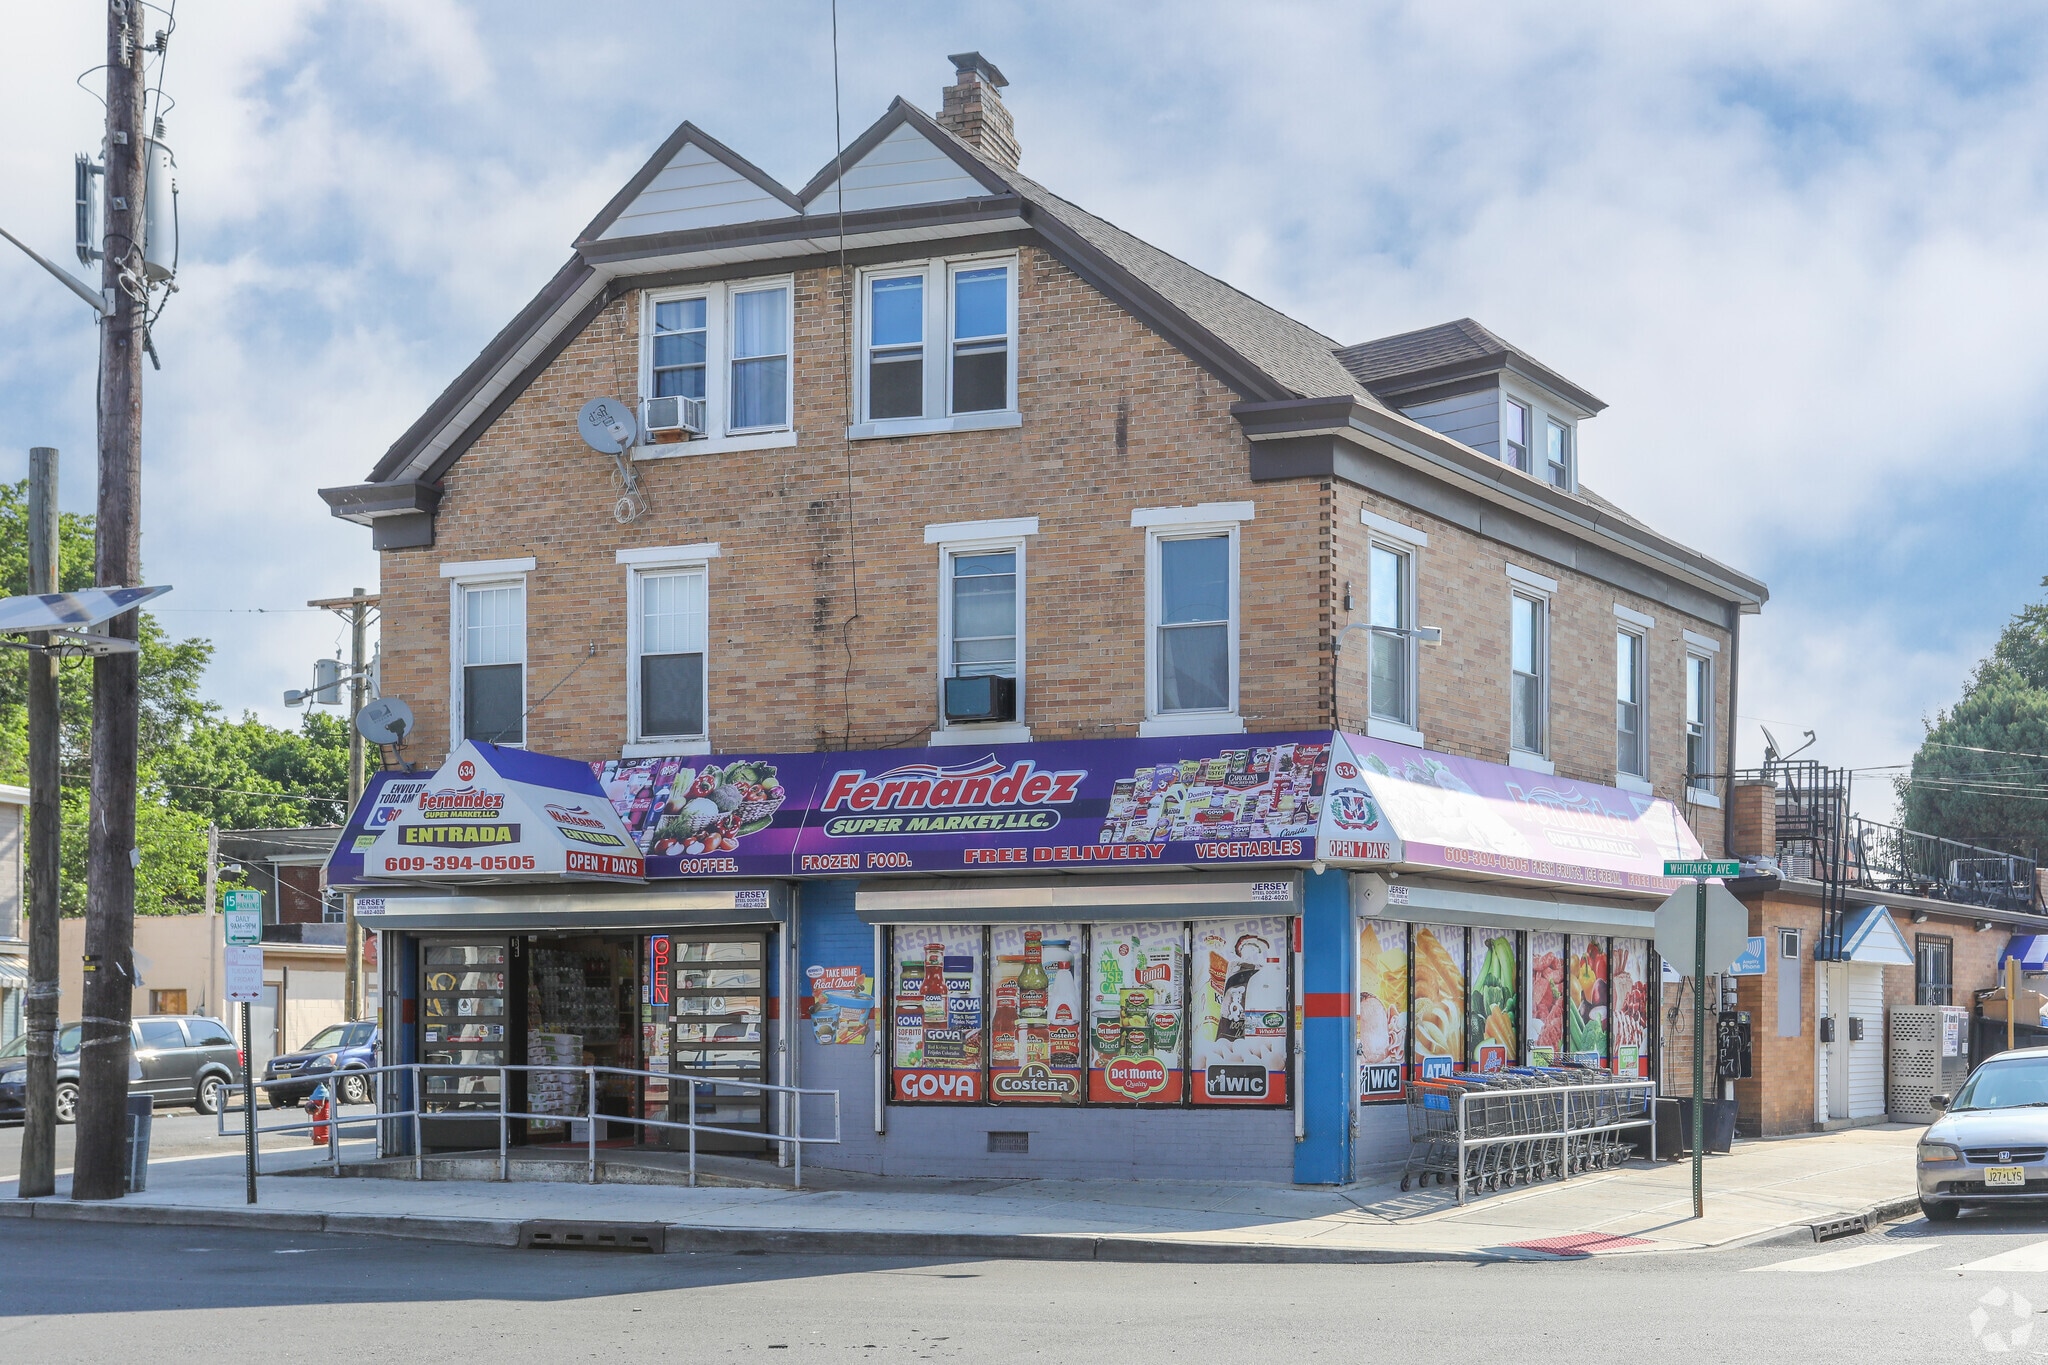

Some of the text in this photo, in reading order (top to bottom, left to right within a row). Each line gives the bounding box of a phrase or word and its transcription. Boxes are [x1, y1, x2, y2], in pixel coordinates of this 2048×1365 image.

[460, 765, 474, 777] 634
[1336, 765, 1356, 777] 634
[1228, 774, 1258, 782] CAROLINA
[390, 783, 414, 793] ENVIO
[824, 763, 1086, 811] Fernandez
[379, 794, 418, 804] TODA AM
[418, 790, 504, 810] Fernandez
[1187, 790, 1211, 799] Domino
[425, 811, 449, 819] SUPER
[546, 809, 606, 830] Welcome
[831, 818, 904, 834] SUPER
[406, 826, 512, 843] ENTRADA
[562, 828, 620, 846] ENTRADA
[964, 843, 1166, 864] FREE DELIVERY
[1195, 839, 1303, 859] VEGETABLES
[1329, 840, 1390, 859] OPEN 7 DAYS
[385, 855, 536, 871] 609-394-0505
[569, 853, 638, 874] OPEN 7 DAYS
[680, 858, 739, 873] COFFEE.
[801, 852, 912, 870] FROZEN FOOD.
[1444, 846, 1530, 873] 609-394-0505
[1531, 861, 1554, 875] FRESH
[1585, 868, 1597, 881] ICE
[1670, 863, 1733, 875] WHITTAKER AVE.
[1628, 872, 1650, 887] FREE
[1252, 882, 1288, 890] JERSEY
[1389, 885, 1409, 894] JERSEY
[226, 895, 236, 907] 15
[357, 898, 386, 906] JERSEY
[654, 938, 670, 1003] OPEN
[1101, 960, 1119, 972] MA
[825, 967, 858, 978] TAKE HOME
[1107, 972, 1122, 982] SE
[1140, 965, 1166, 982] Tamal
[813, 977, 857, 989] Real Deal
[902, 980, 922, 990] GOY
[945, 980, 970, 991] GOYA
[1101, 982, 1117, 994] CA
[950, 998, 981, 1011] GOYA
[897, 1015, 922, 1026] GOYA
[898, 1028, 921, 1036] SOFRITO
[927, 1030, 960, 1040] GOYA
[1028, 1067, 1044, 1078] La
[1111, 1068, 1163, 1079] Del Monte
[1426, 1063, 1451, 1079] ATM
[1001, 1078, 1068, 1091] Costeña
[1125, 1080, 1147, 1088] Quality
[1370, 1068, 1398, 1089] WIC
[901, 1074, 974, 1098] GOYA
[1988, 1171, 2022, 1182] J27 LYS
